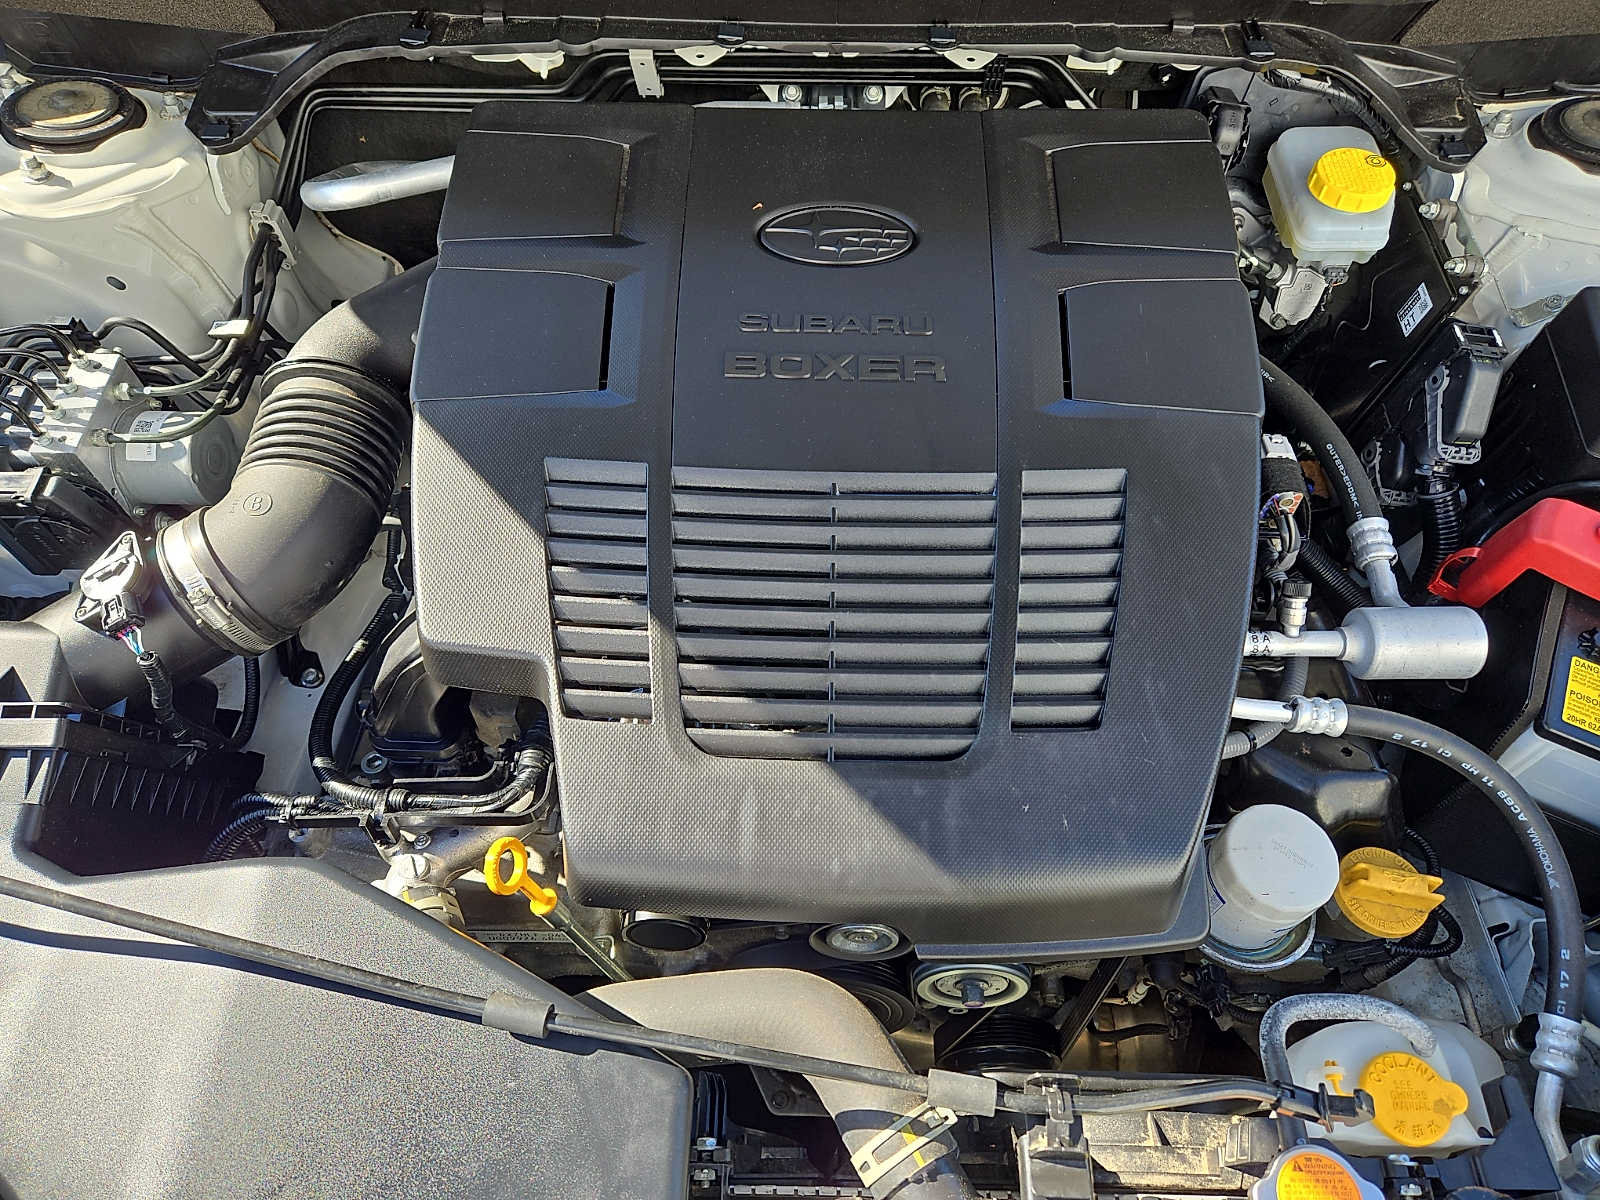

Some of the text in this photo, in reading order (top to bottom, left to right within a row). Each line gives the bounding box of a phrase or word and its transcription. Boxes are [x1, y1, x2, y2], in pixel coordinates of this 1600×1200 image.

[738, 313, 934, 336] SUBARU
[724, 352, 948, 383] BOXER
[1461, 762, 1480, 776] HP
[1527, 826, 1556, 877] YOKOHAMA
[1561, 948, 1570, 960] 2
[1560, 970, 1570, 989] 17
[1368, 1056, 1438, 1082] COOLANT
